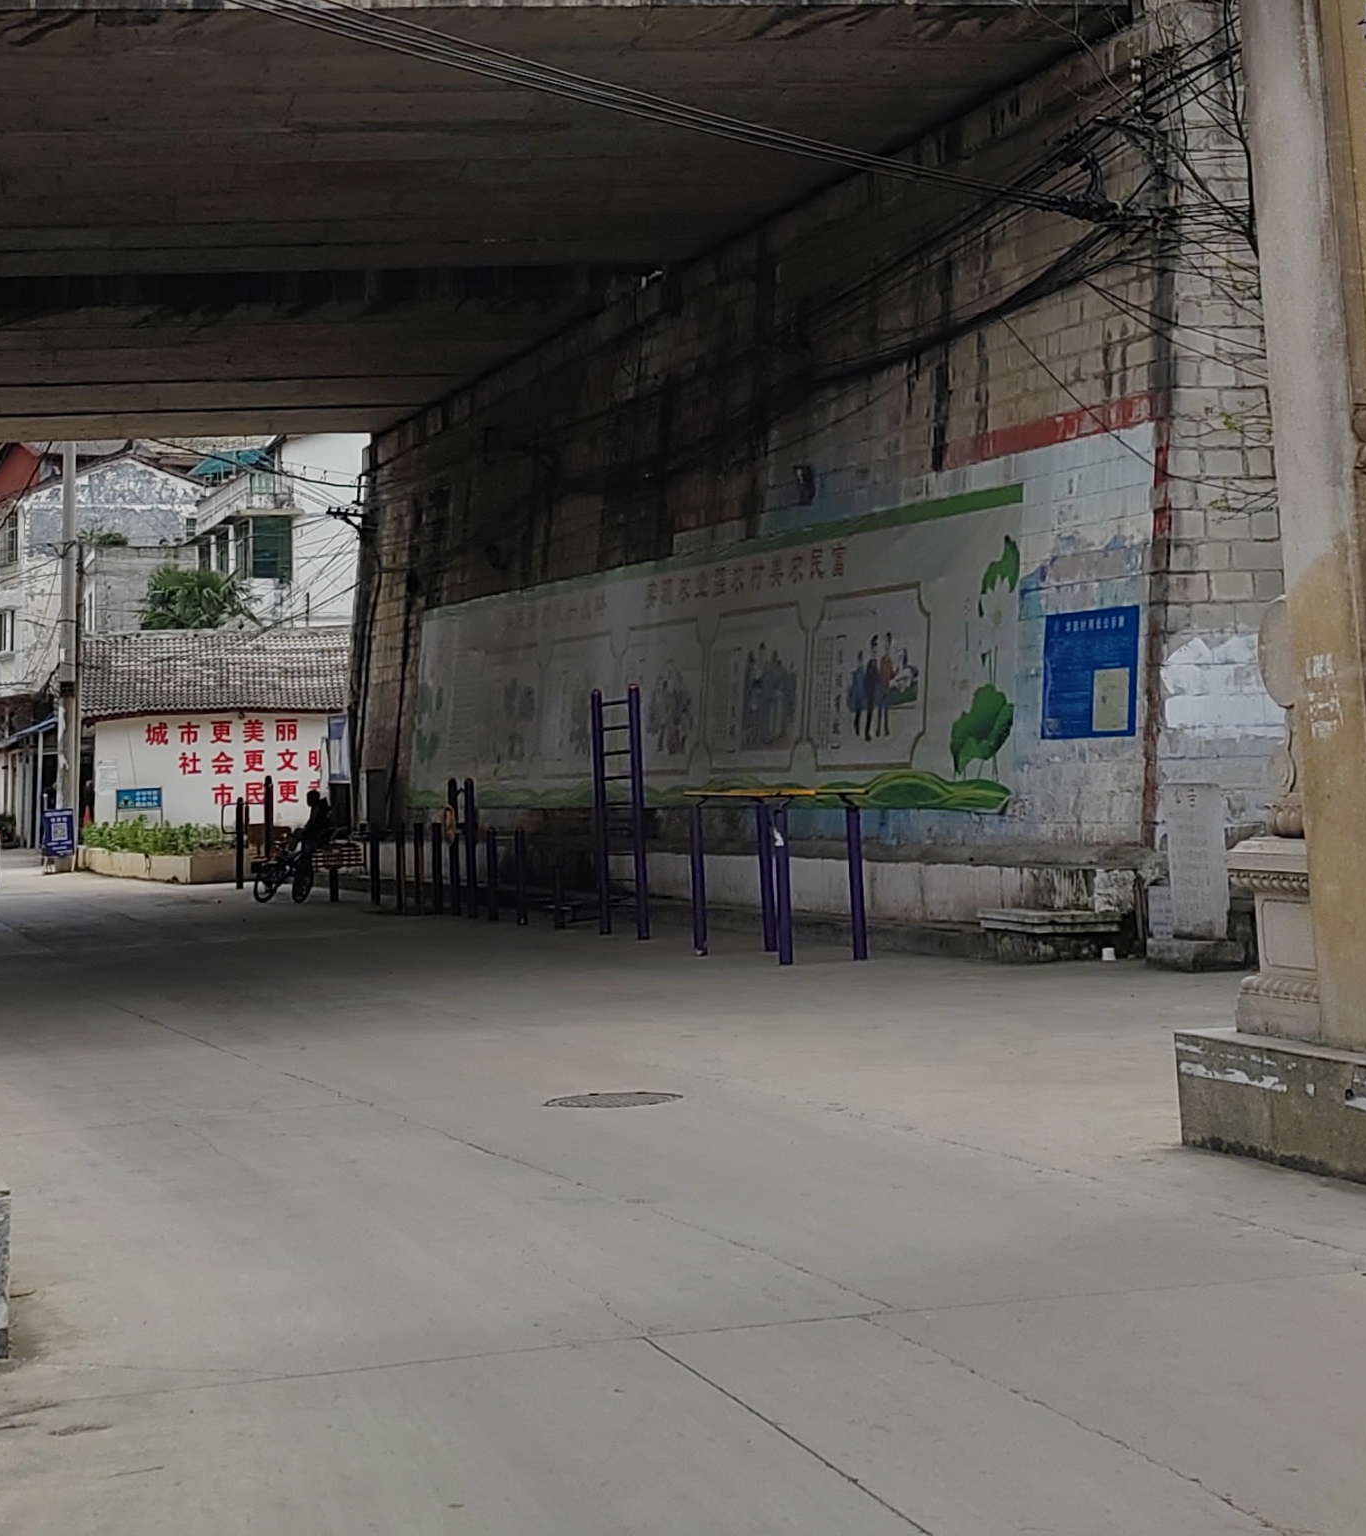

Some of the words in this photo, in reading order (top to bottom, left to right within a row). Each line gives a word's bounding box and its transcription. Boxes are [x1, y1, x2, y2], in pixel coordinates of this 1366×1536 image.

[145, 717, 299, 745] 城市更美丽
